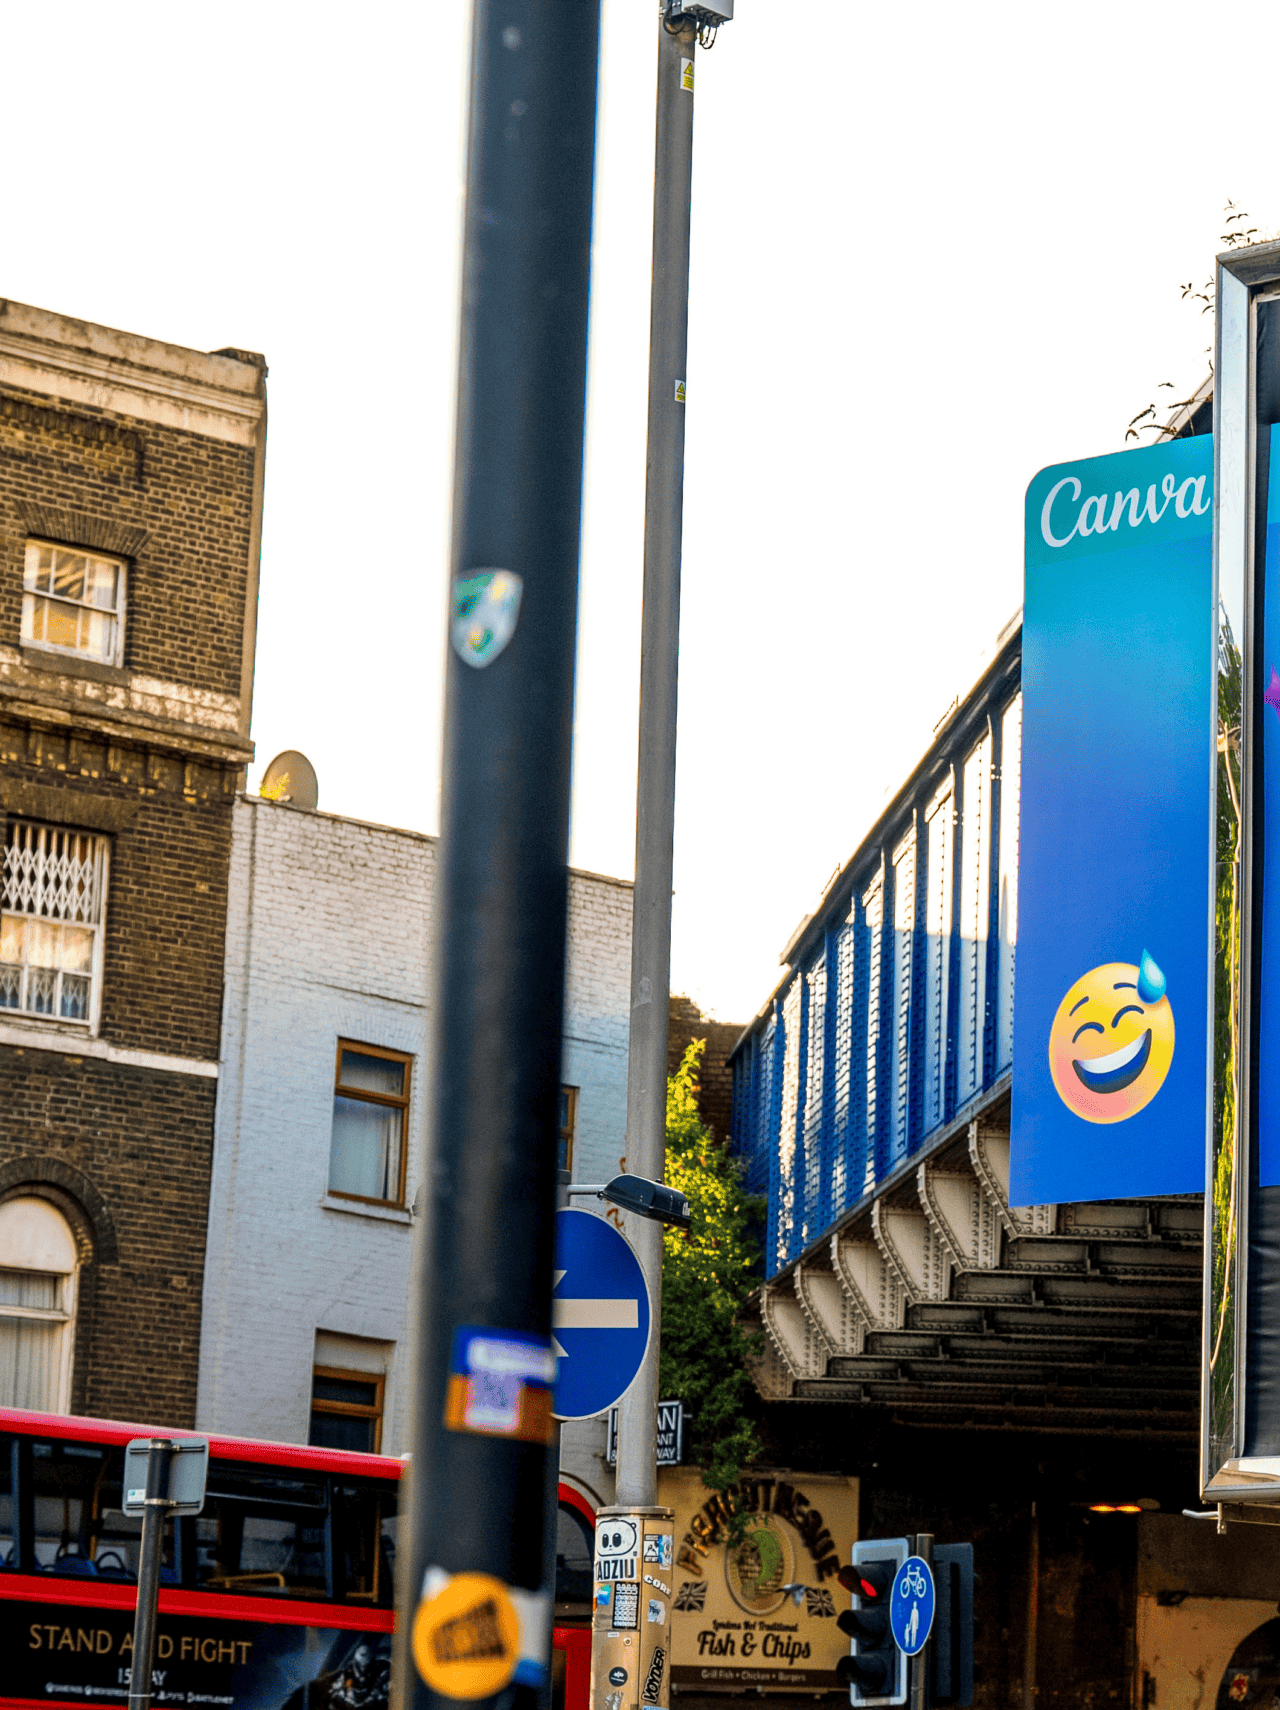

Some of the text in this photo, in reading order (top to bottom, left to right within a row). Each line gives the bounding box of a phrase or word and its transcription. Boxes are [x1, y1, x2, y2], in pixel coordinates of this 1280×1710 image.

[1041, 473, 1210, 547] Canva
[29, 1623, 252, 1665] STAND AD FIGHT
[697, 1630, 811, 1666] Fish & Chips
